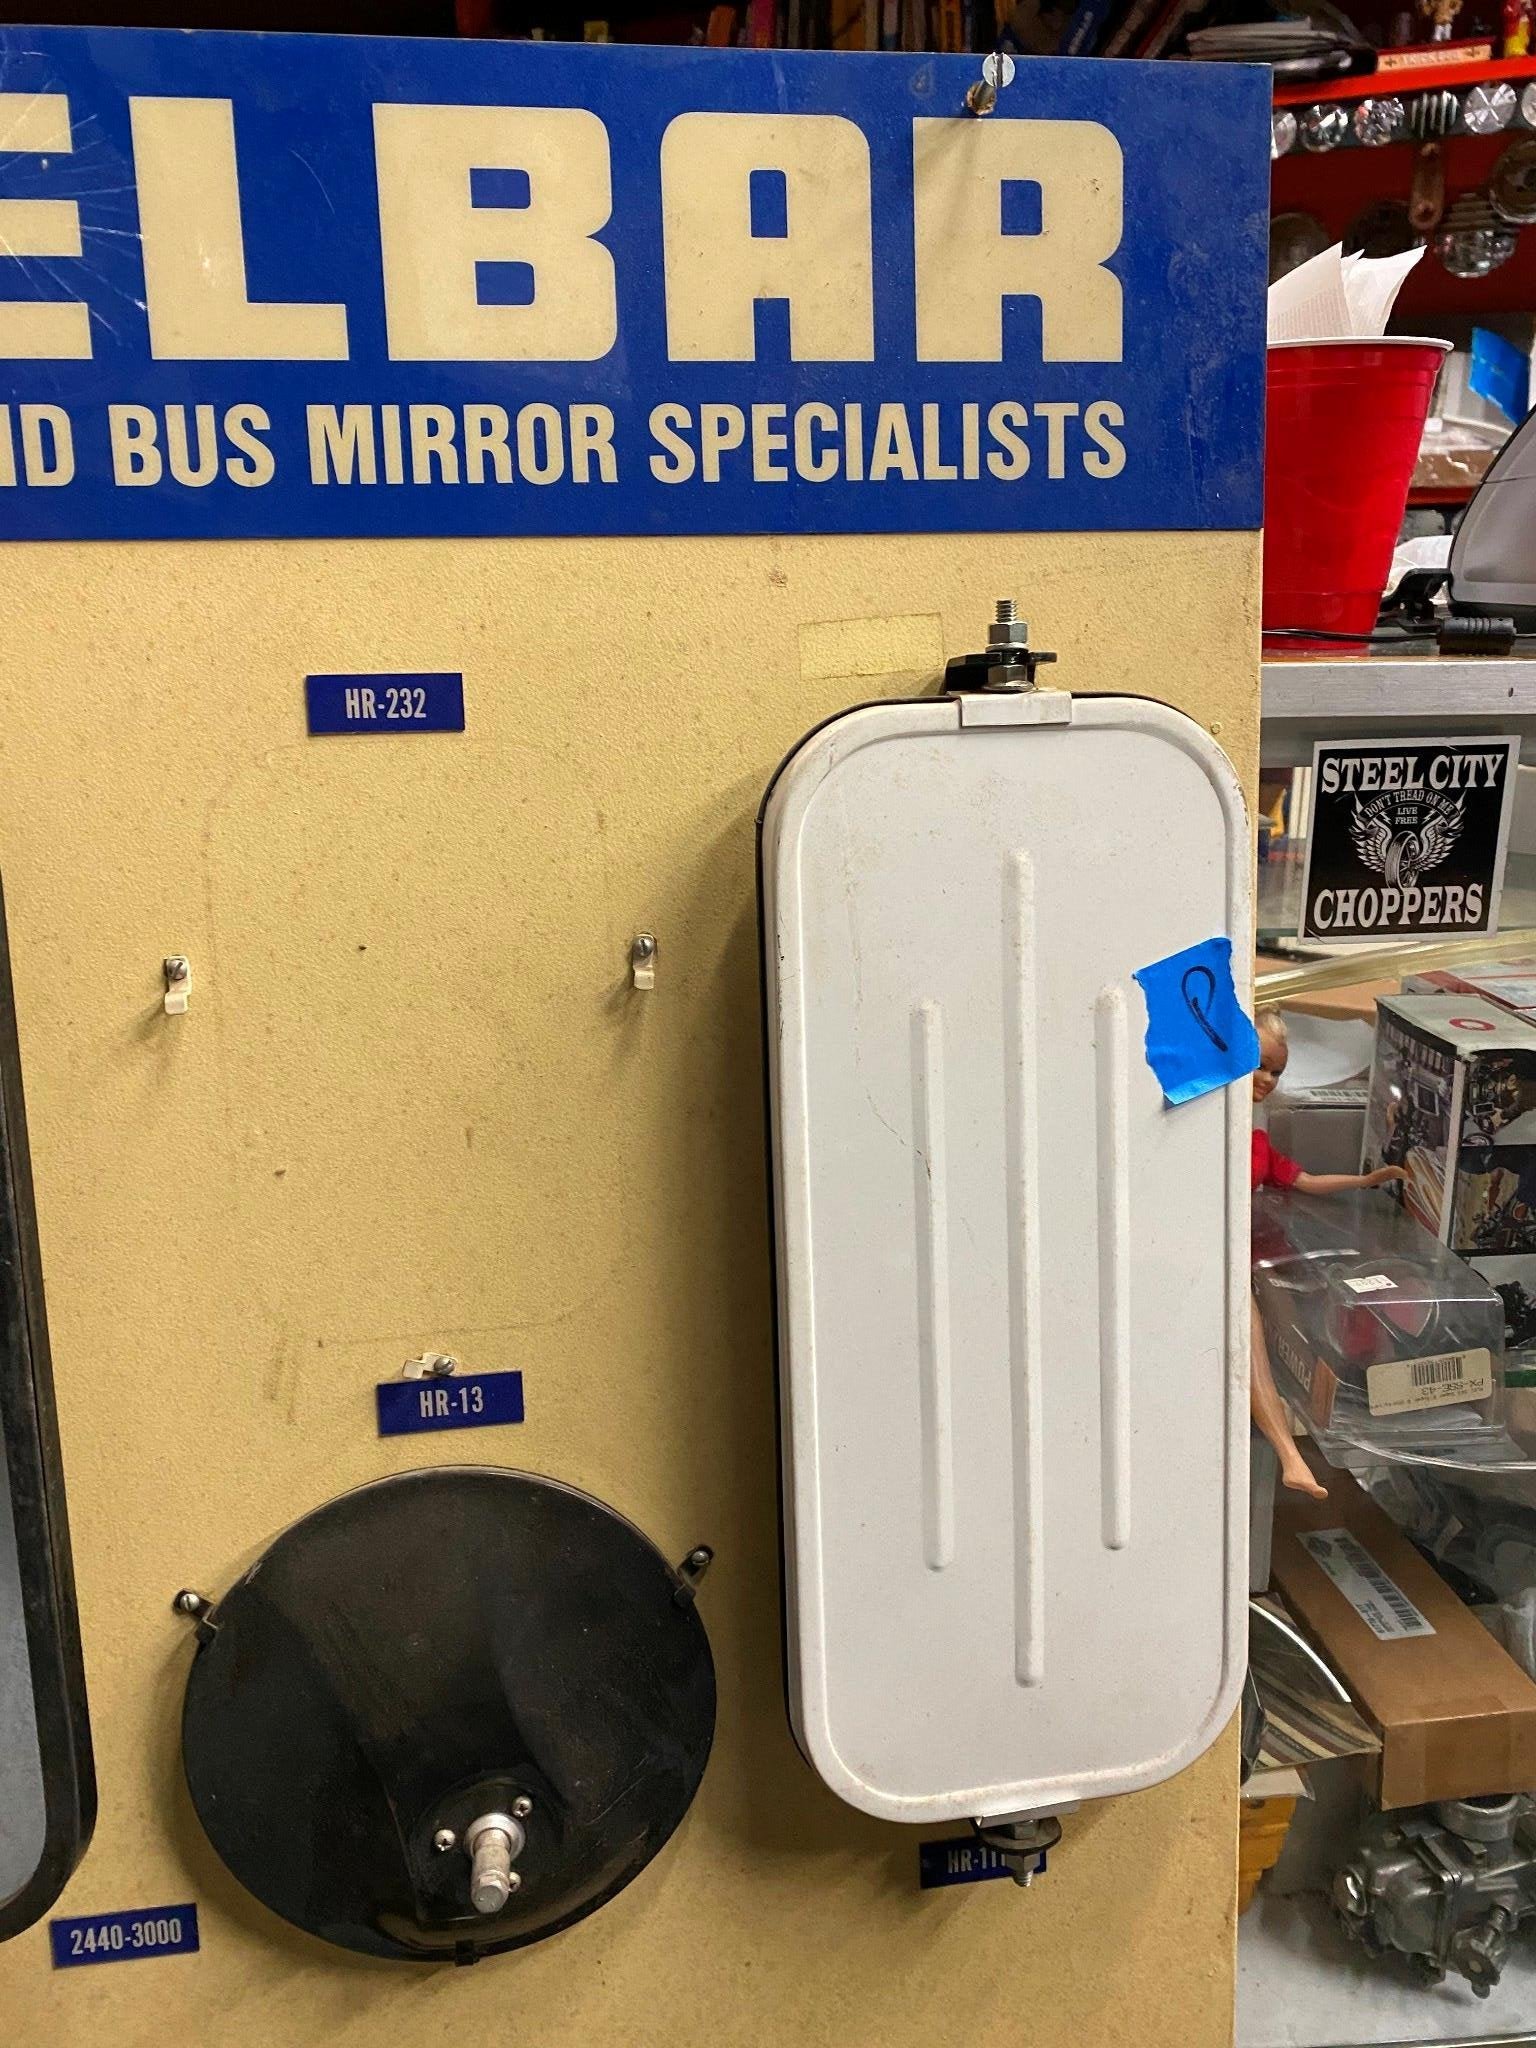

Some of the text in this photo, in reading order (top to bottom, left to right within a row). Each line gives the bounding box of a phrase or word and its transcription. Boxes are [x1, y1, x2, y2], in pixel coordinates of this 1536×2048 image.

[108, 403, 275, 487] BUS
[306, 403, 618, 485] MIRROR
[649, 401, 1127, 484] SPECIALISTS
[344, 687, 427, 719] HR-232
[1321, 754, 1505, 793] STEEL CITY
[1364, 789, 1455, 818] DON'T TREAD ON ME
[1397, 807, 1418, 815] LIVE
[1394, 816, 1418, 825] FREE
[1313, 883, 1484, 930] CHOPPERS
[419, 1385, 485, 1418] HR-13
[70, 1917, 182, 1956] 2440-3000
